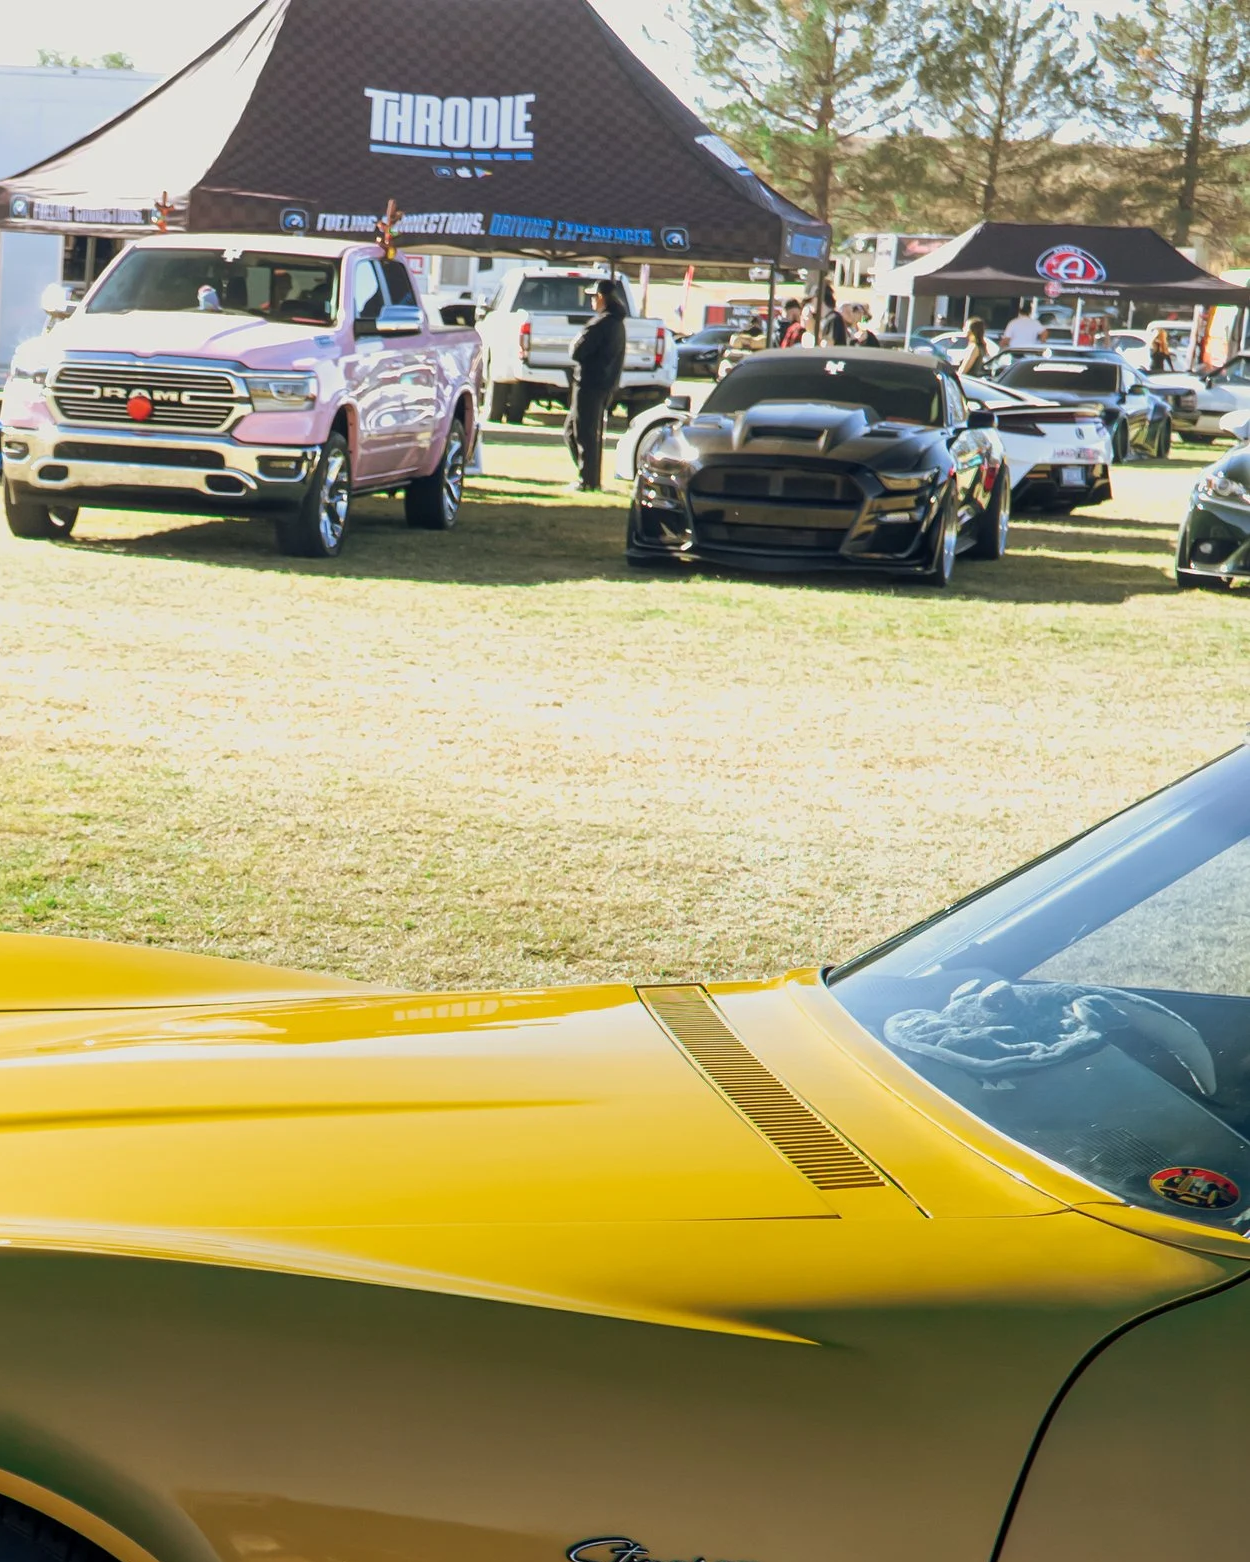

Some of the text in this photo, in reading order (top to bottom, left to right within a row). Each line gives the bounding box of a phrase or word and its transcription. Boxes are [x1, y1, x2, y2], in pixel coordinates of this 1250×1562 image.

[364, 87, 536, 149] THRODLE
[316, 213, 378, 232] FUELING
[488, 213, 553, 240] DRIVING
[102, 386, 179, 402] RAM
